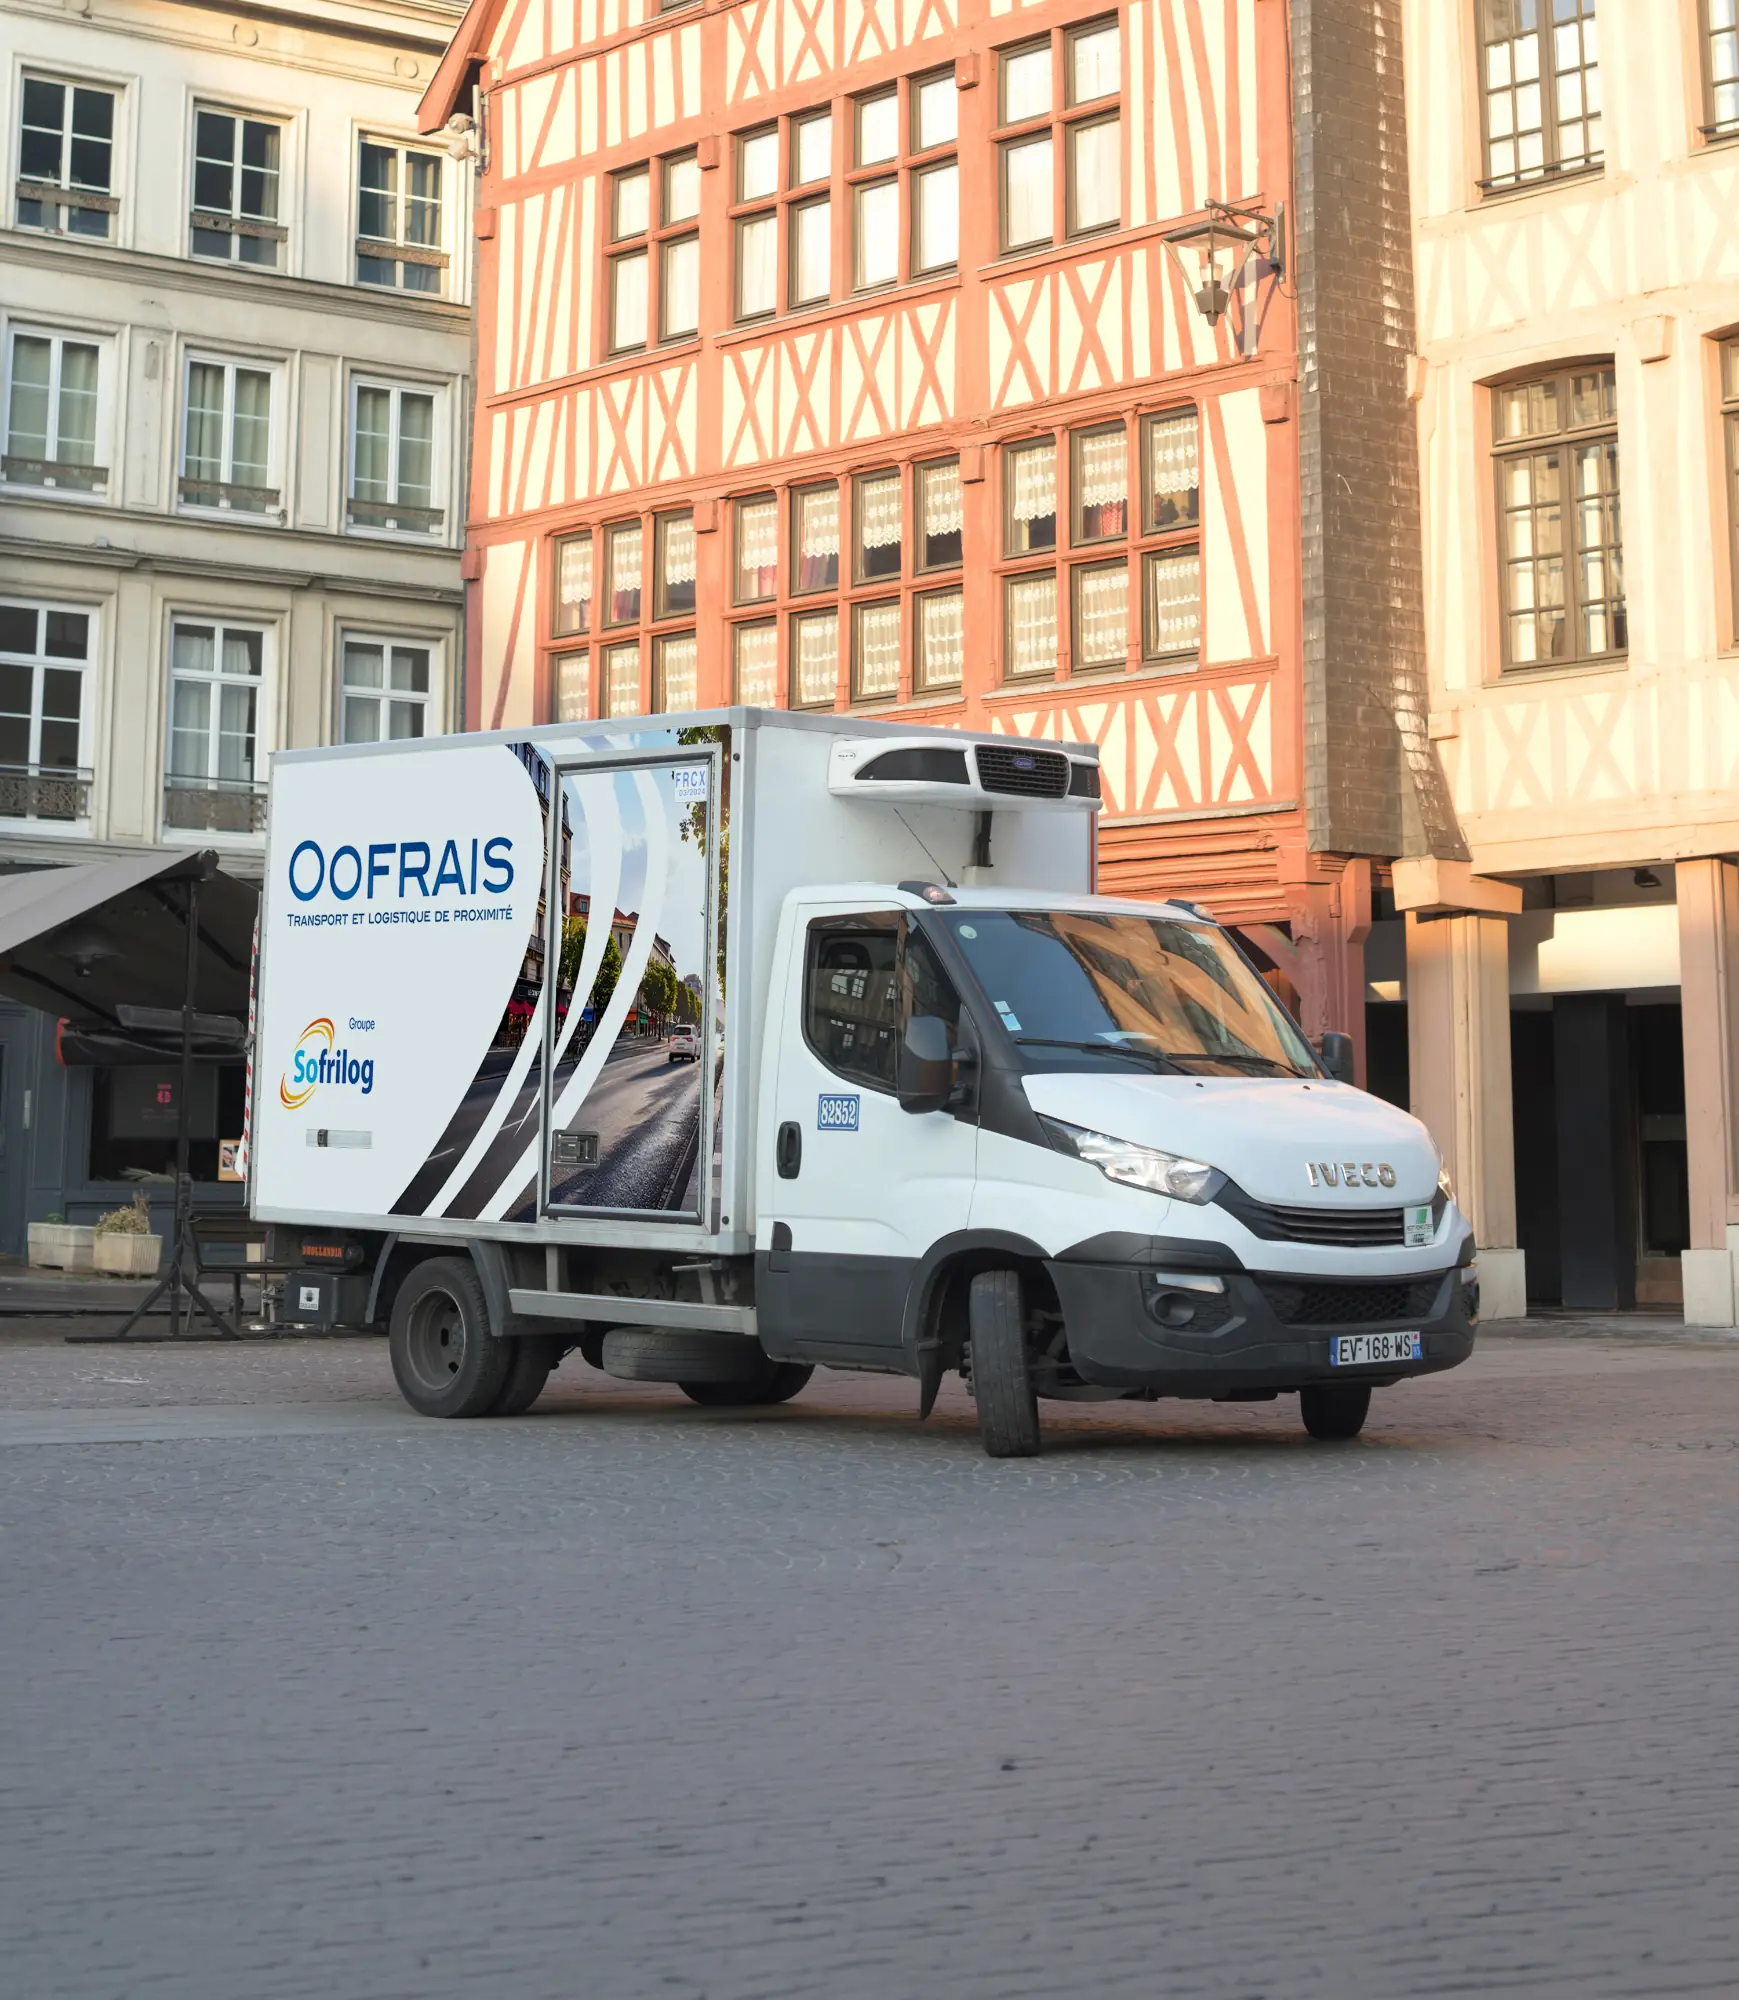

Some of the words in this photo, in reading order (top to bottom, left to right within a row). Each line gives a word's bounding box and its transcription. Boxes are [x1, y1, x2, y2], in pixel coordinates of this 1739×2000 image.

[675, 770, 706, 788] FRCX
[678, 787, 706, 797] 03/2024
[289, 837, 514, 902] OOFRAIS
[287, 913, 349, 927] TRANSPORT
[352, 912, 365, 925] ET
[368, 910, 431, 924] LOGISTIQUE
[434, 910, 450, 922] DE
[453, 904, 513, 922] PROXIMITÉ
[349, 1017, 375, 1032] Groupe
[293, 1048, 375, 1094] Sofrilog
[821, 1099, 856, 1125] 82852
[1305, 1161, 1397, 1188] IVECO
[1340, 1335, 1411, 1362] EV-168-WS
